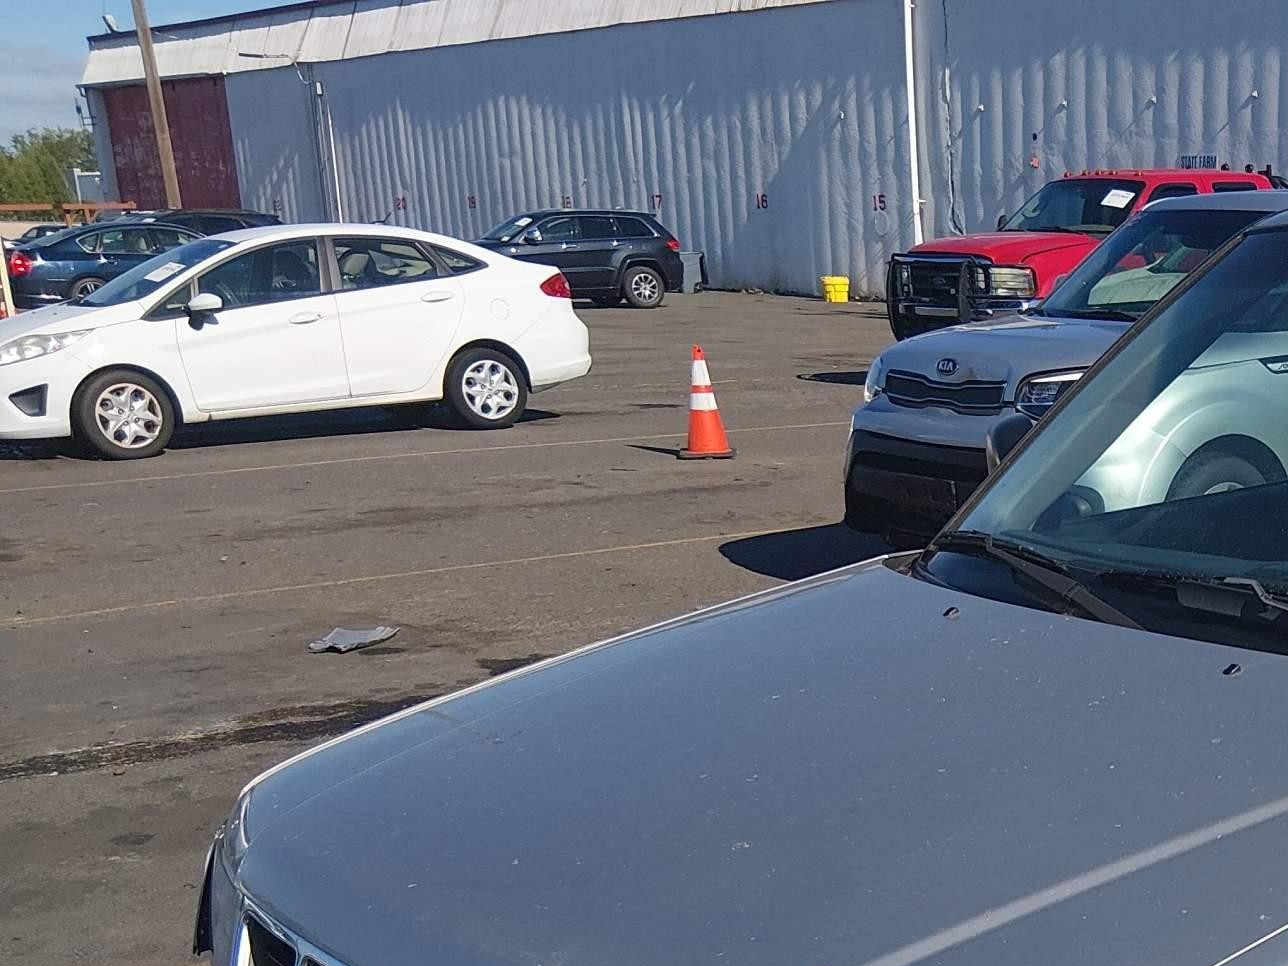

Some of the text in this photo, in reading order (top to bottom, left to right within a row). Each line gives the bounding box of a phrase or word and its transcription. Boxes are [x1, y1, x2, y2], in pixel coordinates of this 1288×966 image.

[1180, 155, 1217, 169] STATE FARM
[395, 198, 407, 211] 20
[467, 196, 477, 209] 19
[561, 195, 572, 209] 18
[651, 195, 663, 210] 17
[756, 193, 769, 209] 16
[873, 195, 887, 211] 15
[938, 360, 954, 371] KIA
